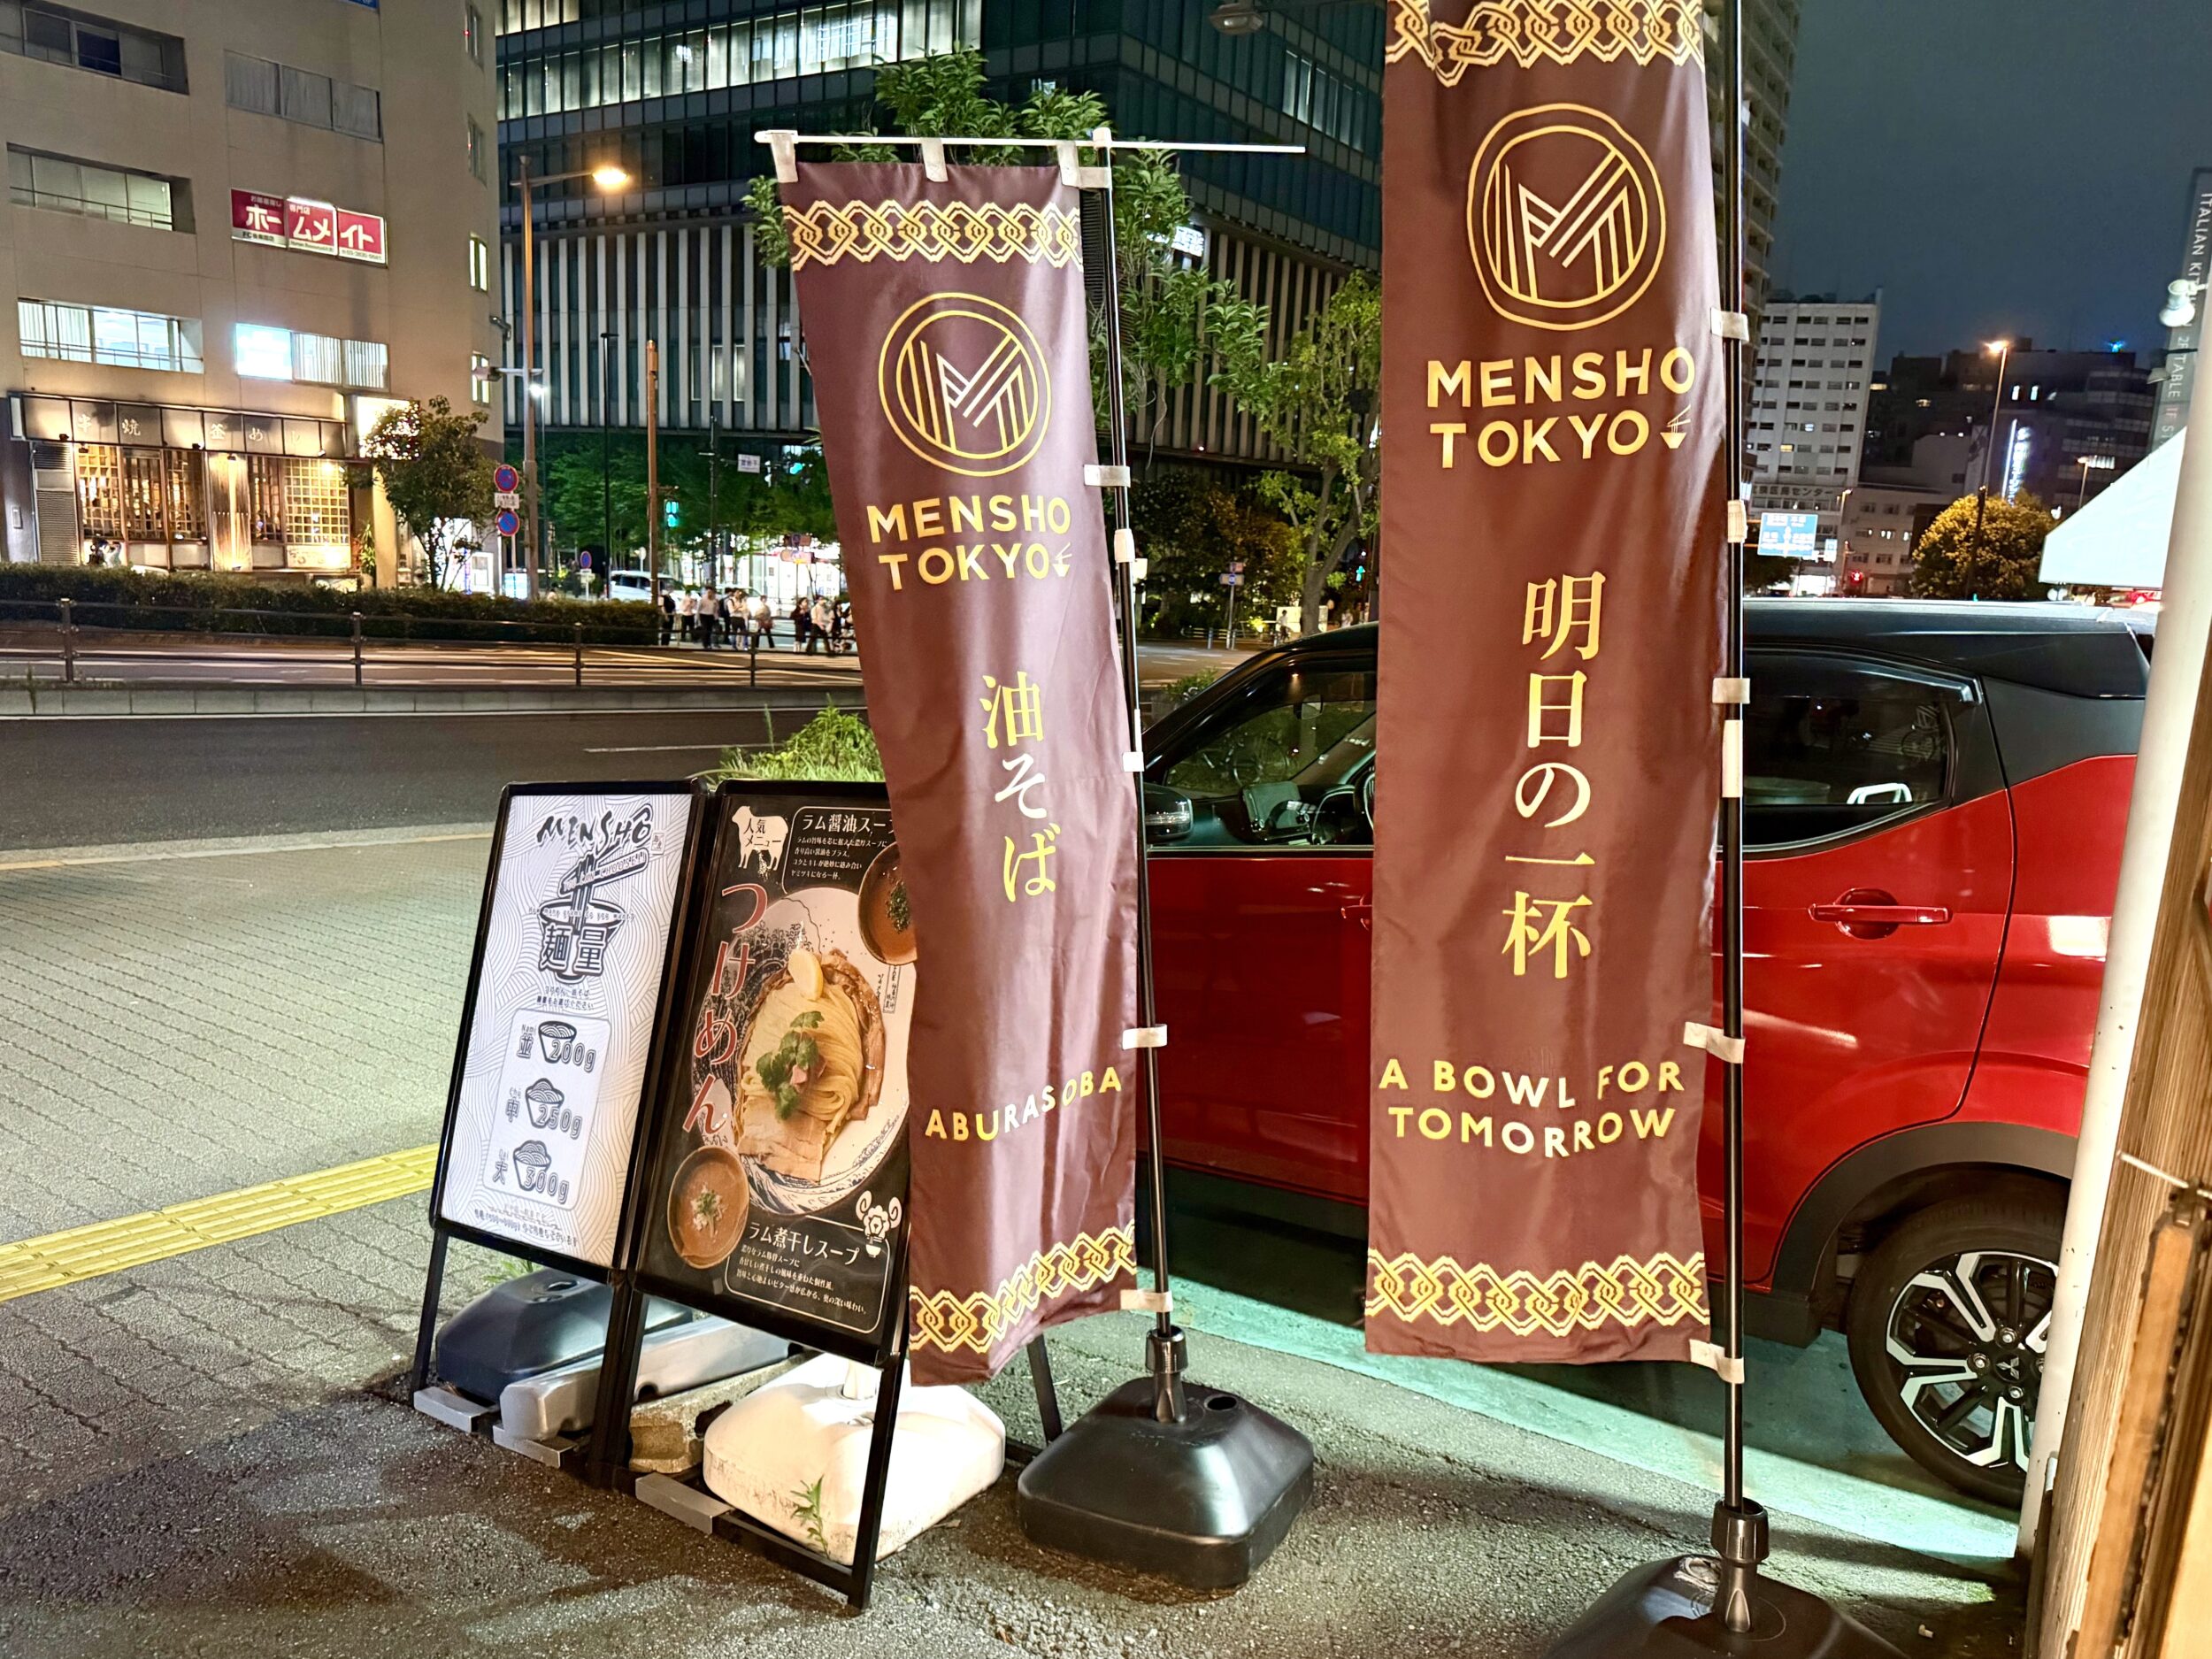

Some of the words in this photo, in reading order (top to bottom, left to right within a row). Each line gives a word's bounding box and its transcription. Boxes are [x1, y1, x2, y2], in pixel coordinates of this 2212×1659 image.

[246, 204, 375, 250] ホームメイト
[2192, 193, 2212, 255] ITALIAN
[1426, 346, 1695, 409] MENSHO
[2168, 354, 2186, 398] TABLE
[1430, 410, 1649, 469] TOKYO
[866, 495, 1071, 543] MENSHO
[878, 542, 1049, 590] TOKYO
[979, 671, 1061, 902] 油そば
[1502, 571, 1606, 979] 明日の一杯
[743, 818, 767, 834] 人気
[745, 835, 782, 848] メニュー
[541, 924, 605, 972] 麺量
[521, 1024, 536, 1034] Nami
[682, 883, 768, 1135] つけめん
[517, 1033, 534, 1059] 並
[549, 1039, 596, 1072] 200g
[925, 1066, 1122, 1141] ABURASOBA
[1379, 1058, 1409, 1089] A
[1433, 1060, 1576, 1109] BOWL
[1597, 1061, 1685, 1100] FOR
[535, 1104, 583, 1140] 250g
[1387, 1107, 1676, 1157] TOMORROW
[492, 1160, 508, 1186] 大
[524, 1167, 569, 1204] 300g
[749, 1221, 860, 1265] ラム煮干しスープ
